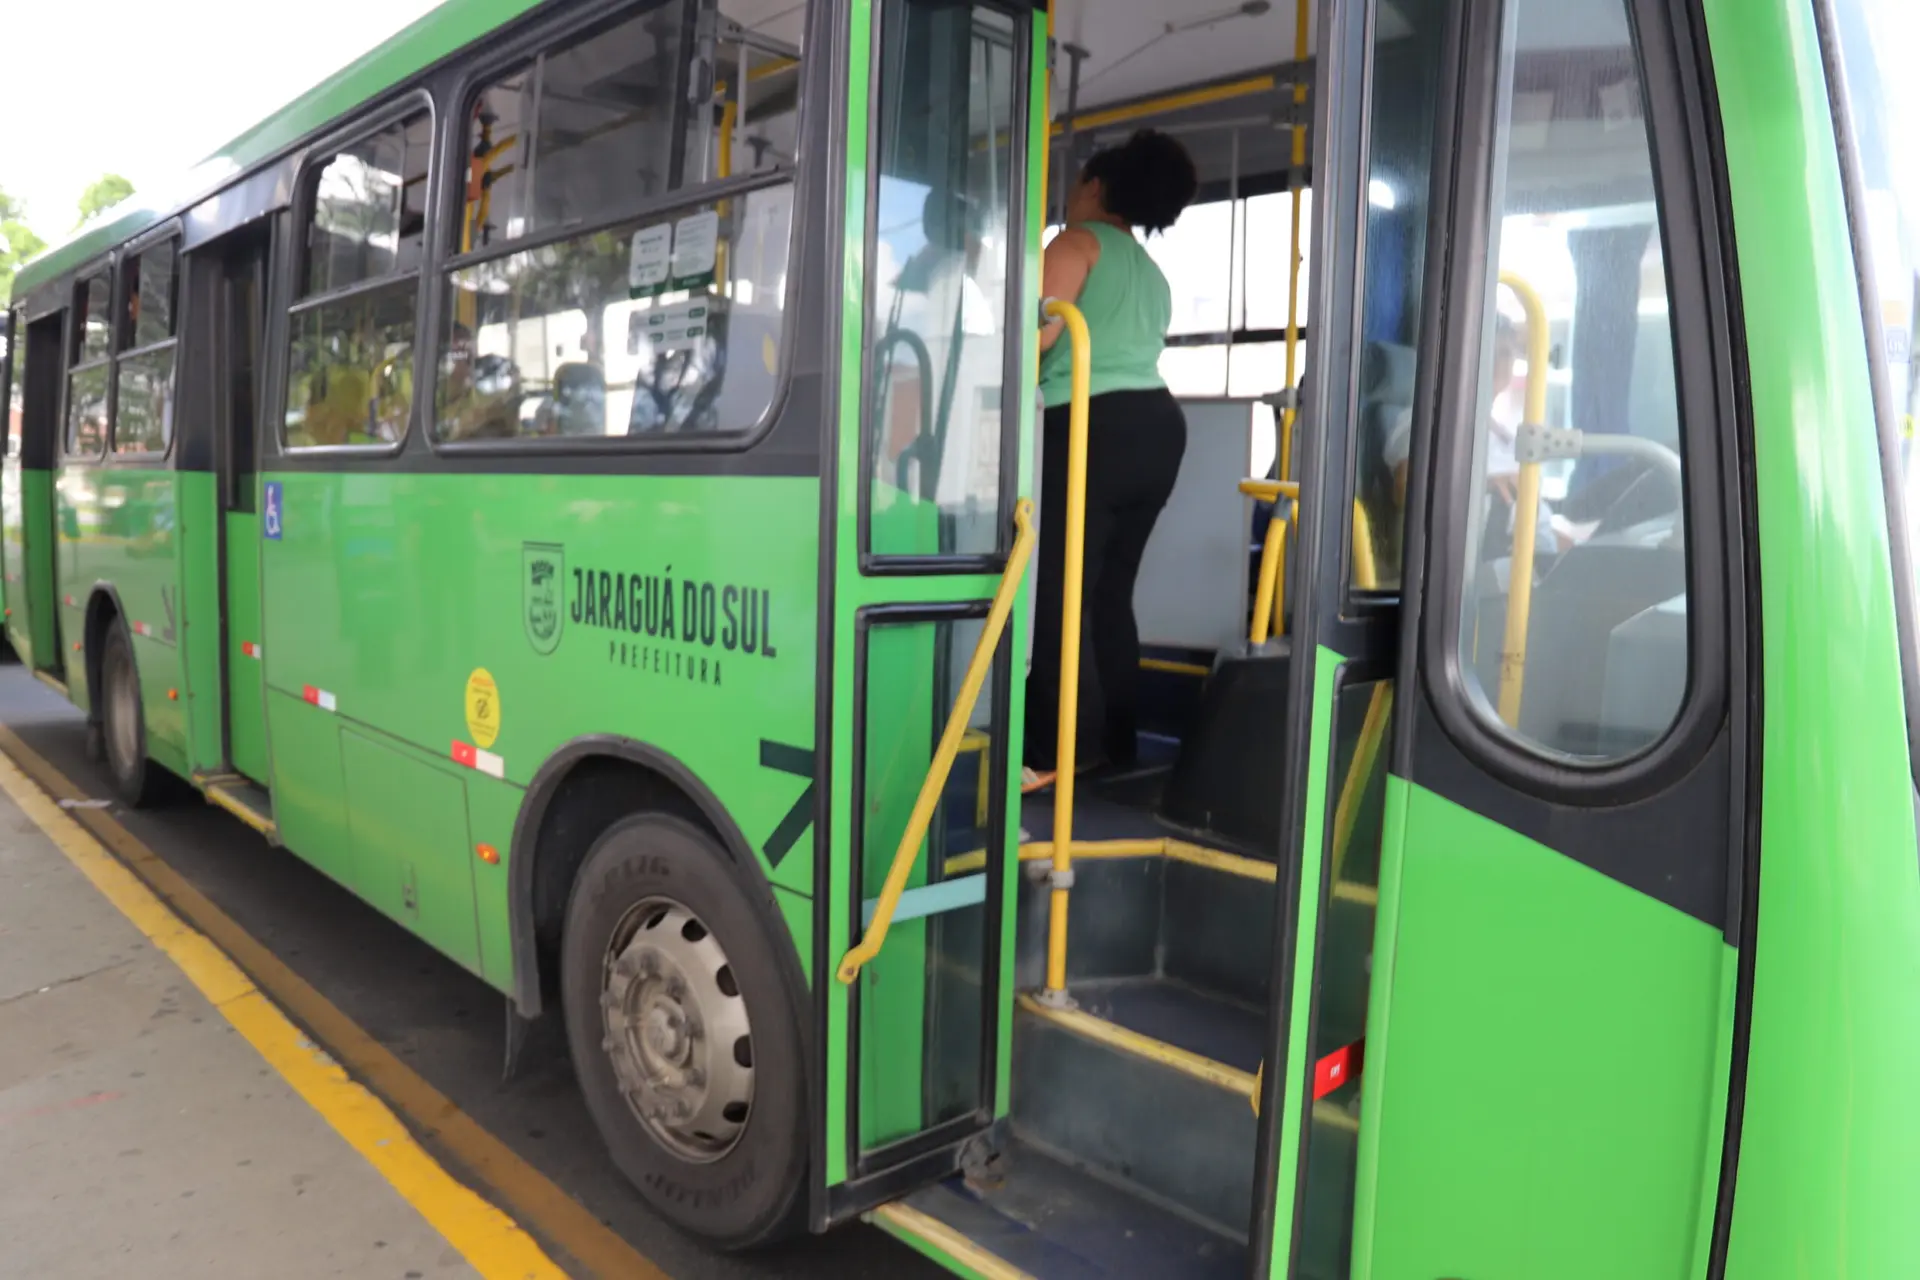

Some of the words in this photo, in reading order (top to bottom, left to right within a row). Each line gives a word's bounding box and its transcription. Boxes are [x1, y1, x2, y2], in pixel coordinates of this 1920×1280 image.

[570, 564, 676, 640] JARAGUÁ
[682, 580, 716, 647] DO
[721, 583, 778, 659] SUL
[609, 640, 722, 686] PREFEITURA
